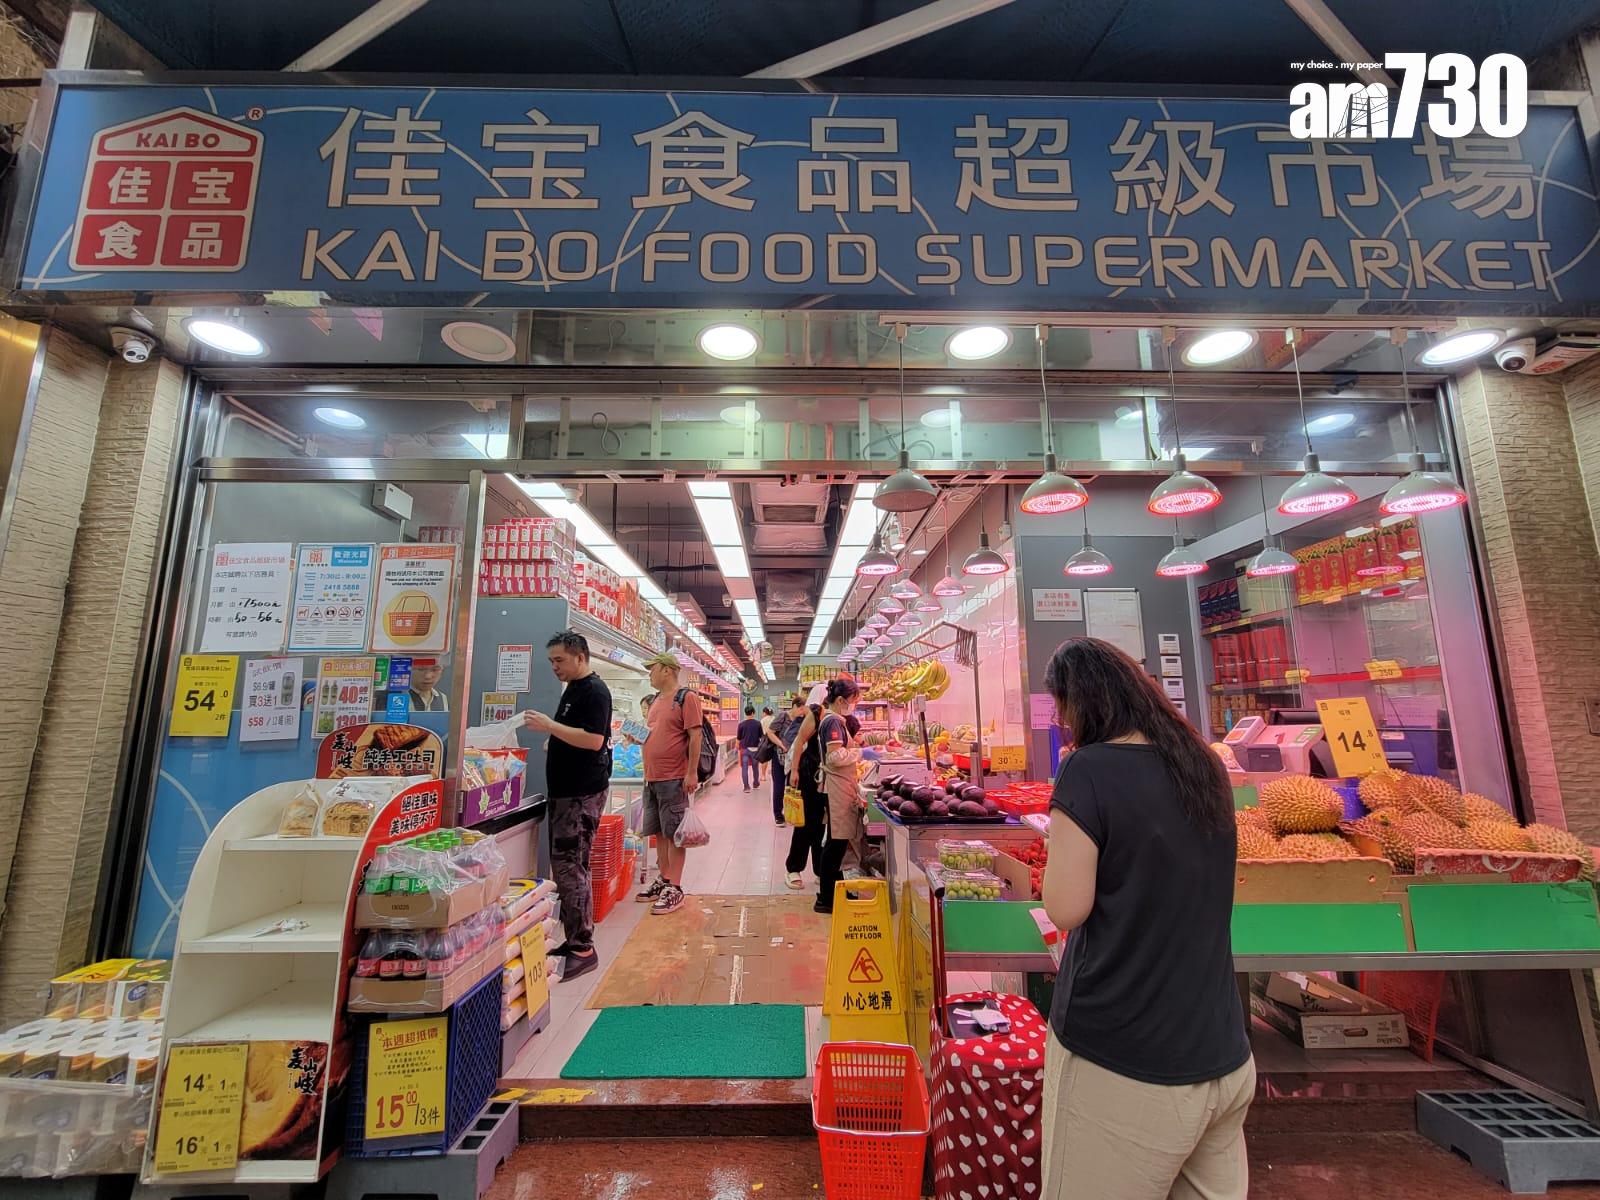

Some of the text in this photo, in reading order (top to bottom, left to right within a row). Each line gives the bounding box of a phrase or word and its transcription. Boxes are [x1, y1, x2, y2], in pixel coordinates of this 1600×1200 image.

[136, 133, 220, 148] KAI BO
[319, 106, 1538, 220] 佳宝食品超級市場
[108, 166, 234, 205] 佳宝
[95, 220, 223, 260] 食品
[301, 229, 1551, 292] KAI BO FOOD SUPERMARKET
[184, 690, 215, 711] 54
[1338, 730, 1366, 752] 14
[364, 748, 436, 763] 純手工吐司
[528, 961, 542, 987] 103
[842, 990, 892, 1010] 小心地滑
[184, 1074, 204, 1092] 14
[376, 1094, 404, 1129] 15
[176, 1136, 198, 1155] 16
